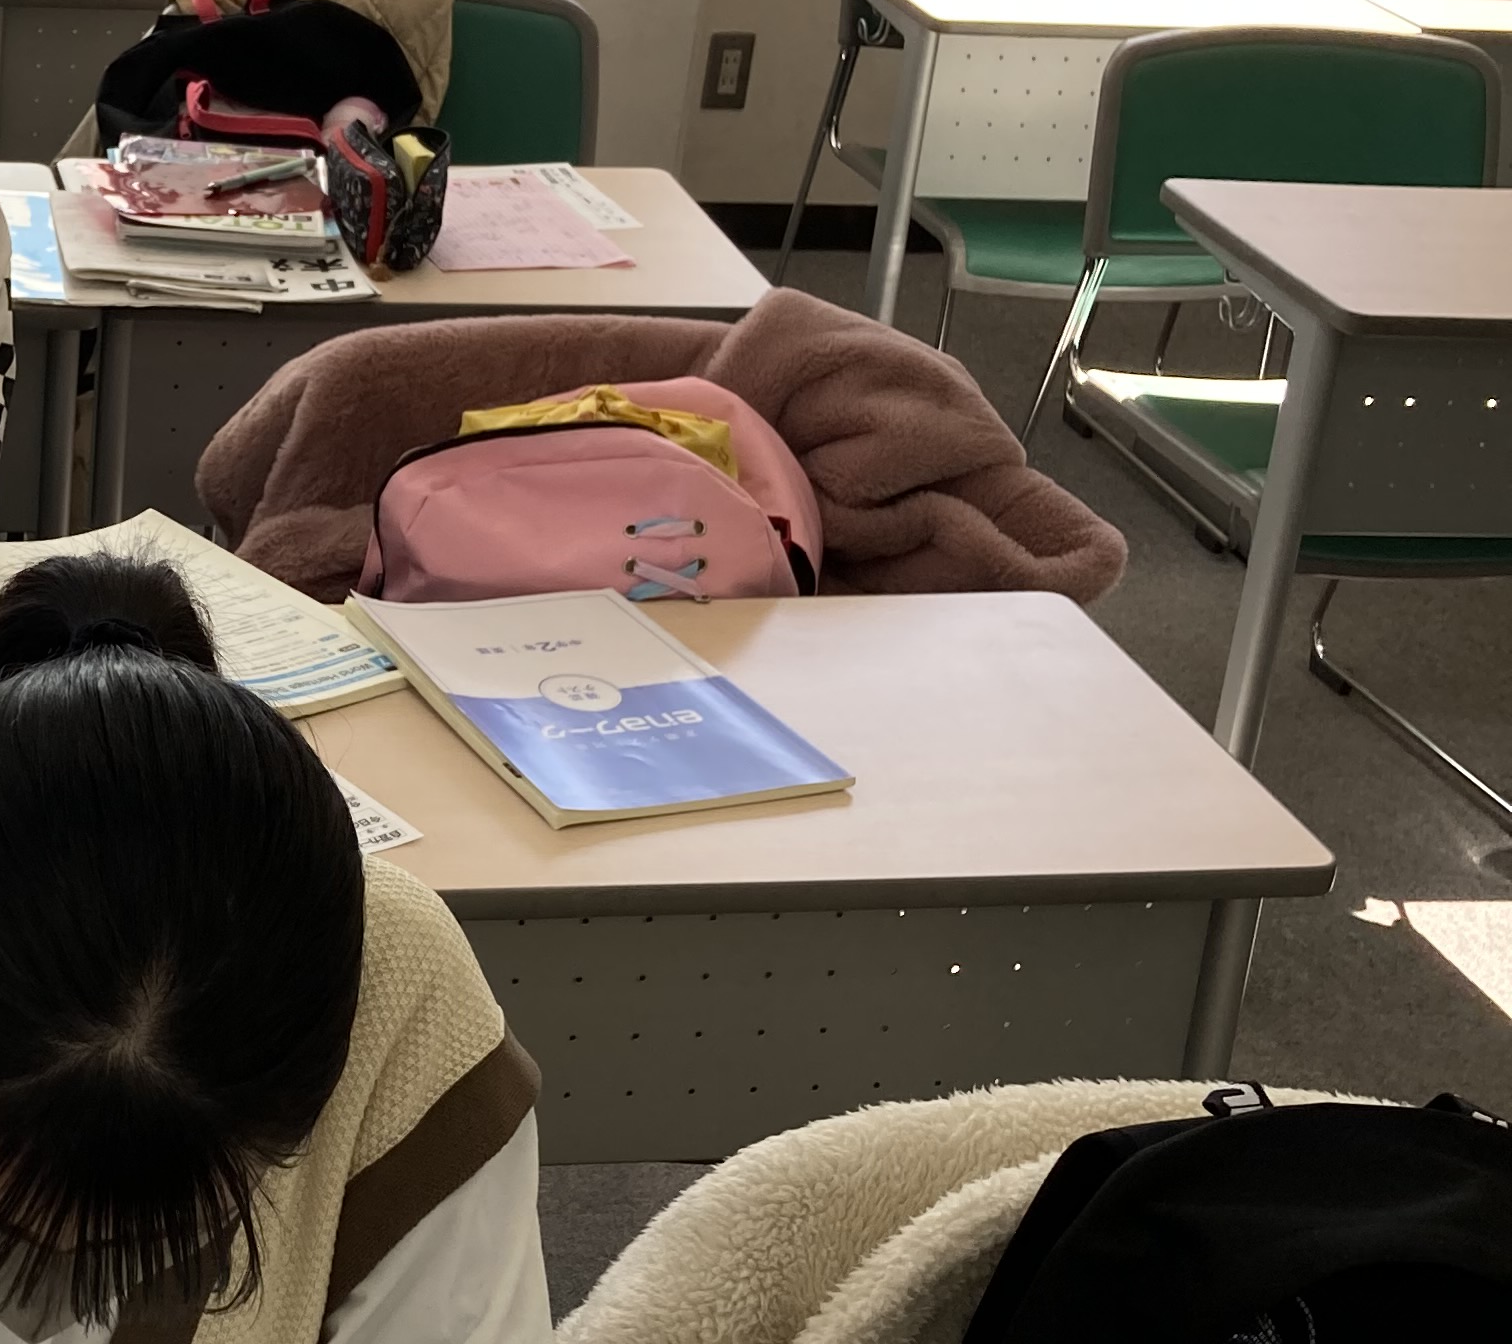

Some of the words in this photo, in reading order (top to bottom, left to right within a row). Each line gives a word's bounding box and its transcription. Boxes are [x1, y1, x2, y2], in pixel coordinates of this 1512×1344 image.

[339, 663, 373, 677] World
[541, 708, 704, 739] enaワーク
